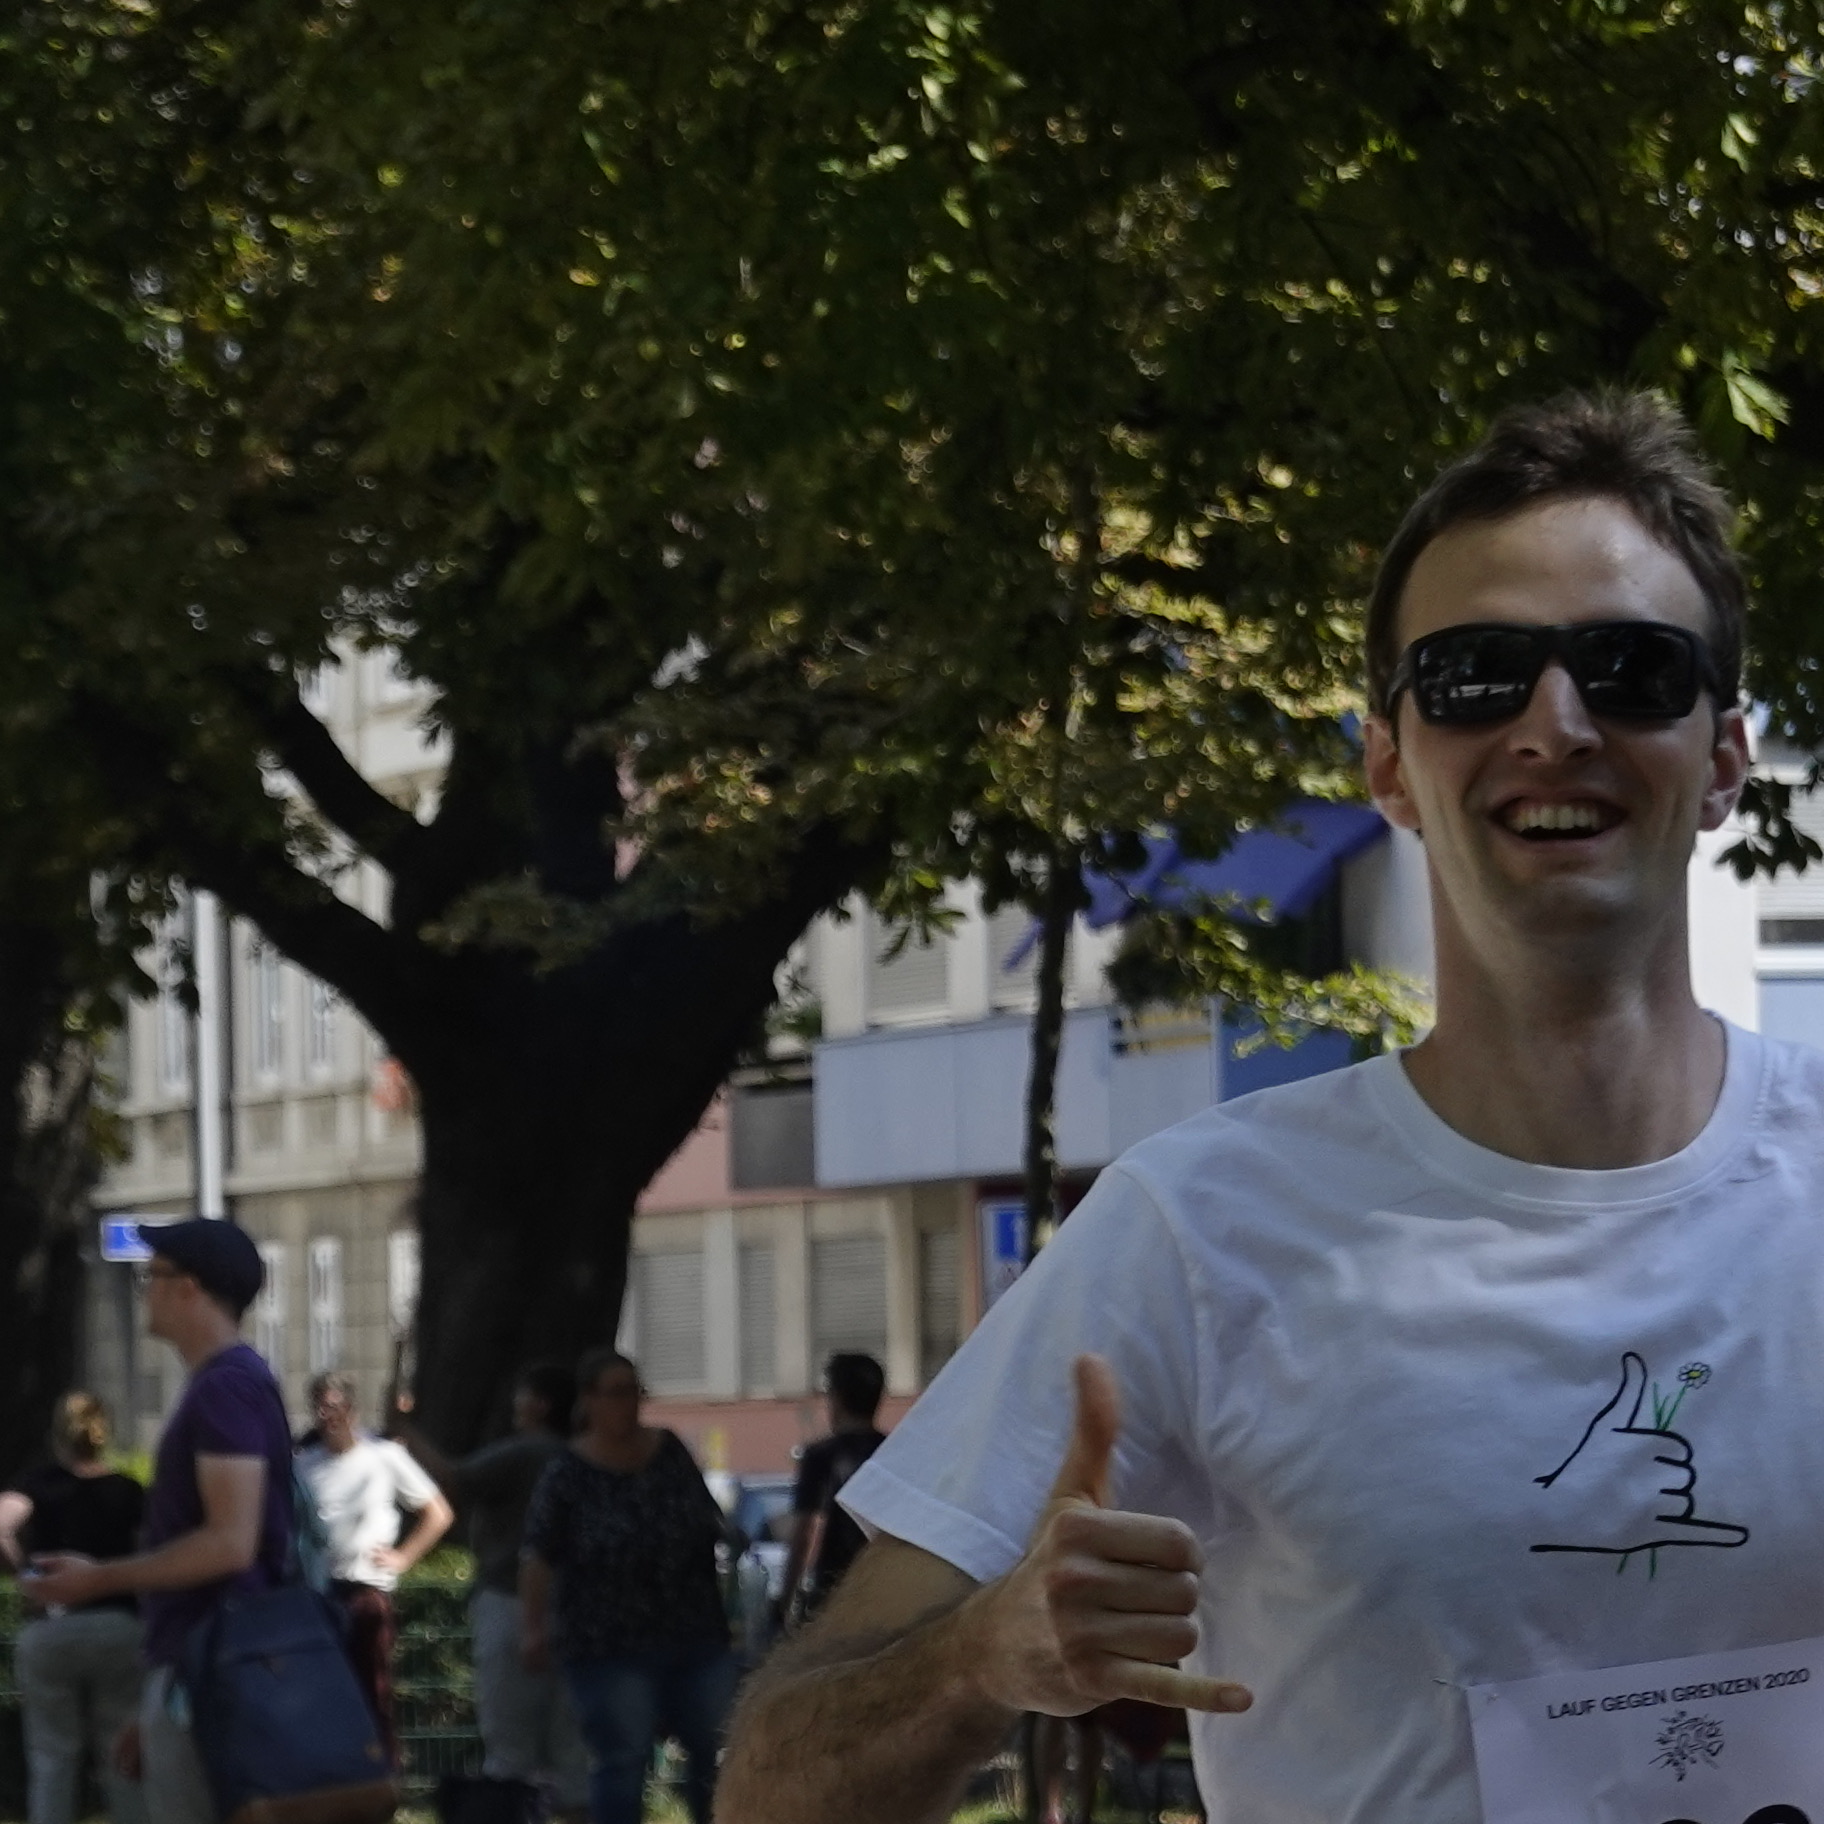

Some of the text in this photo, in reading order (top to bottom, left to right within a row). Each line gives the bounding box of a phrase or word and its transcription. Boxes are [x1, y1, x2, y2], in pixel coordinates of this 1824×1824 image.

[1546, 1667, 1811, 1719] LAUF GEGEN GRENZEN 2020
